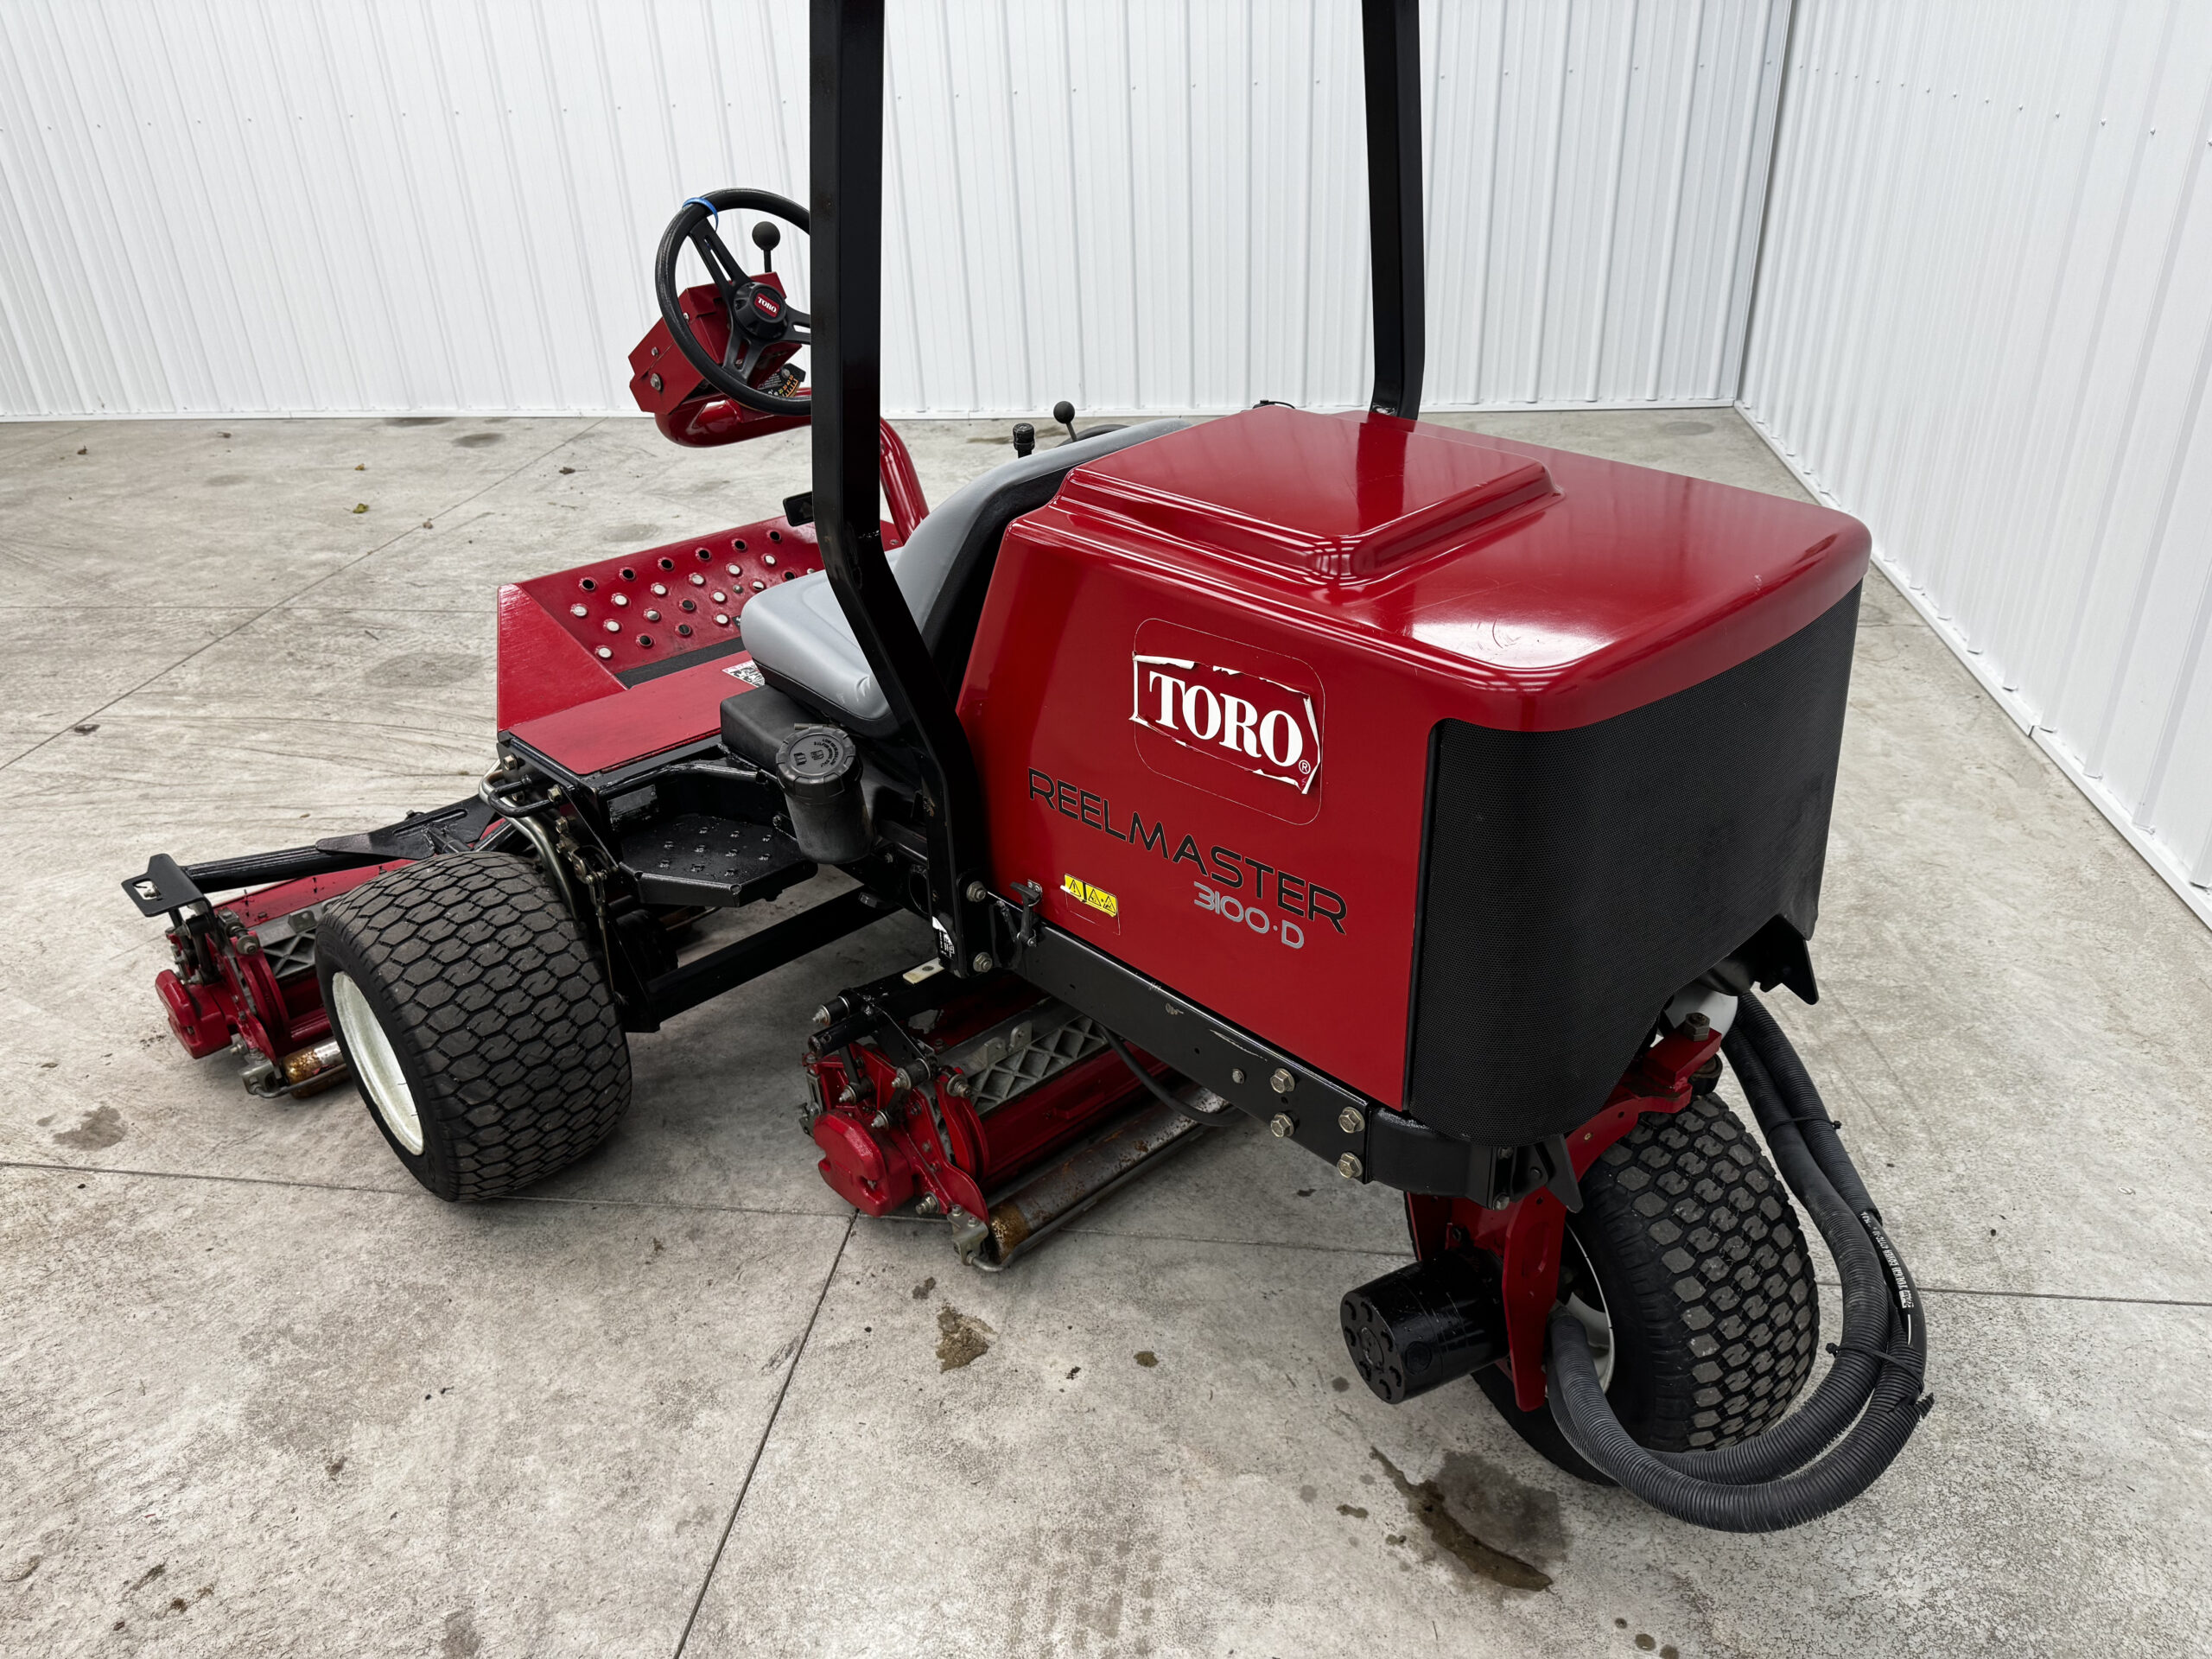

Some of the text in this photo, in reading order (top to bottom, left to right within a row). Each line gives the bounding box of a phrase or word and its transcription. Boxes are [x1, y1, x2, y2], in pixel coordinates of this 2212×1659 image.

[758, 296, 777, 314] TORO
[1149, 671, 1303, 767] TORO
[1028, 767, 1347, 934] REELMASTER
